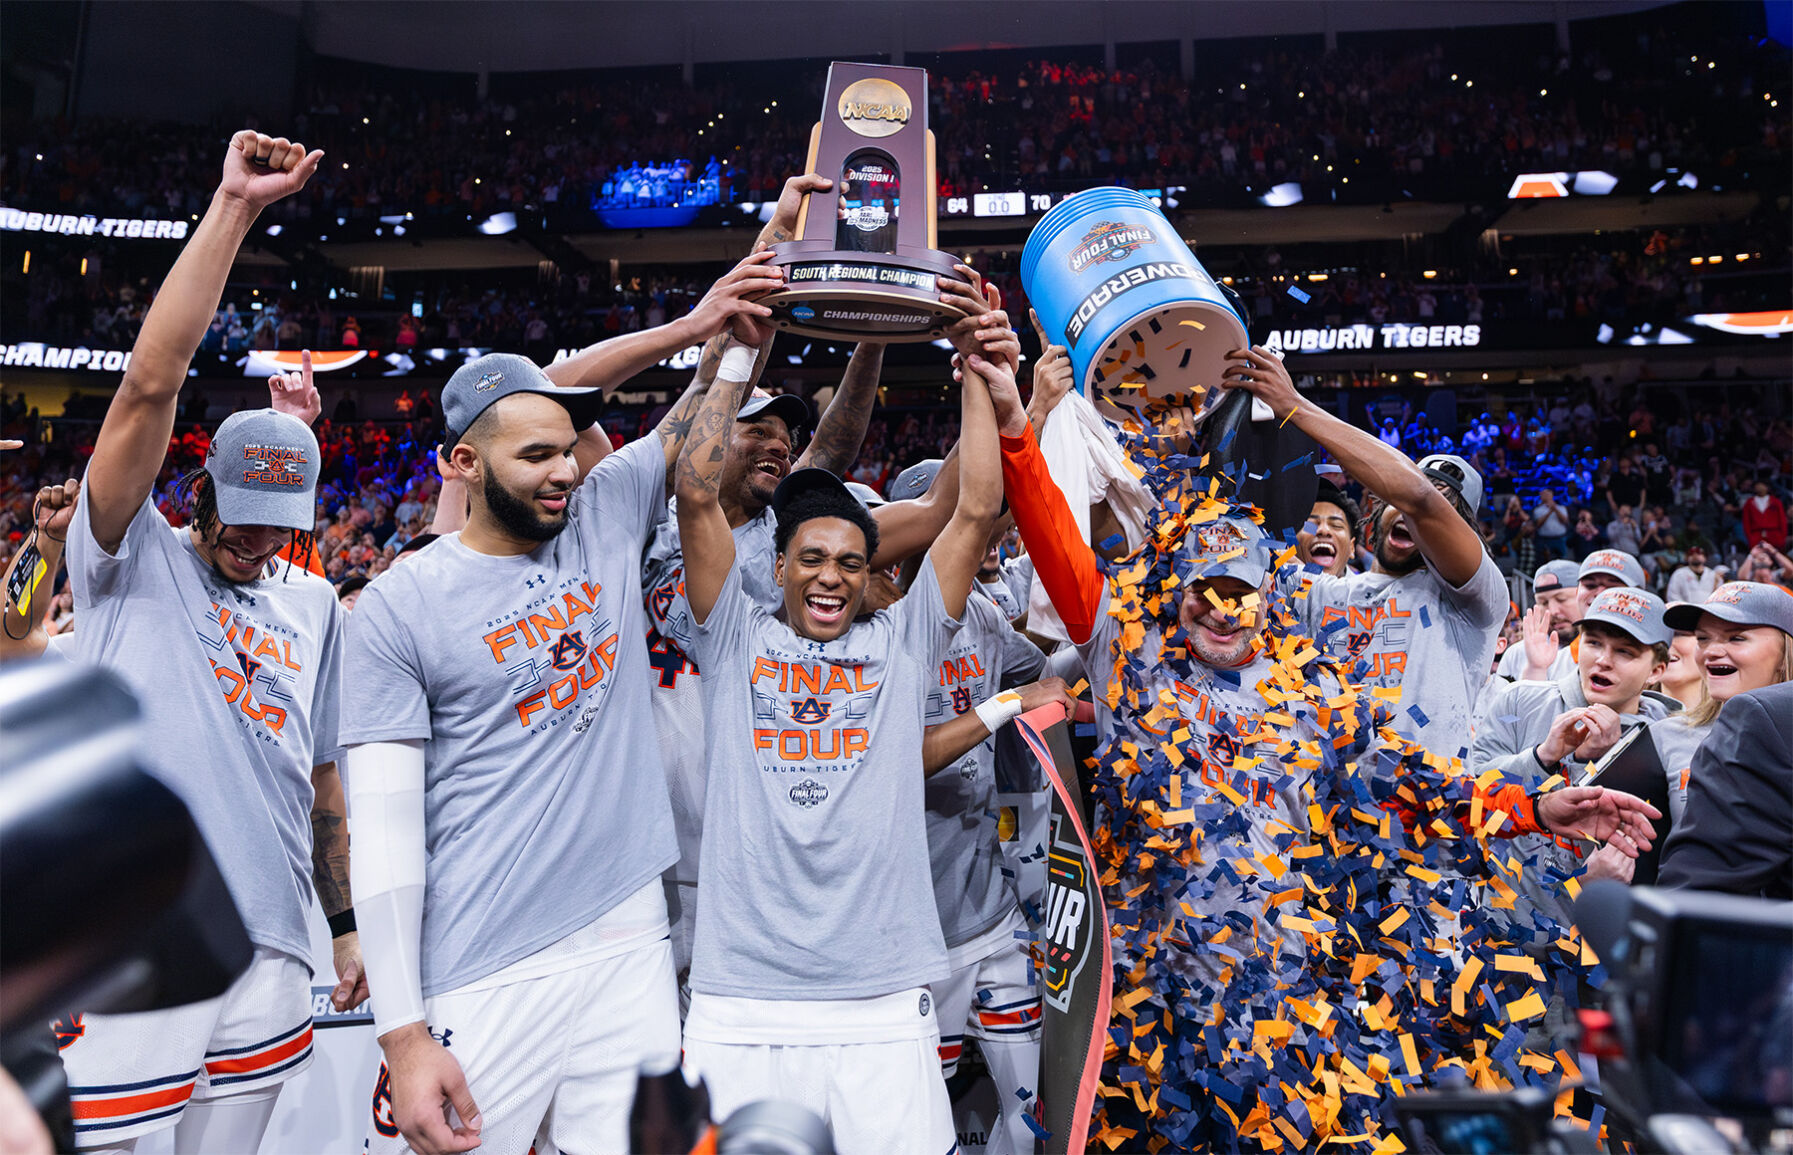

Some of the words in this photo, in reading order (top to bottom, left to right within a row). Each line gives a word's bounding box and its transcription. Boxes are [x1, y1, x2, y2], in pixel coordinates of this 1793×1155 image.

[843, 102, 908, 124] NCAA
[849, 172, 889, 183] DIVISION
[889, 174, 895, 183] I
[861, 165, 883, 173] 2025
[947, 197, 968, 213] 64
[1030, 194, 1051, 210] 70
[0, 207, 97, 236] AUBURN
[101, 218, 188, 239] TIGERS
[1108, 228, 1152, 246] FINAL
[1072, 238, 1109, 270] FOUR
[792, 266, 827, 281] SOUTH
[828, 266, 877, 280] REGIONAL
[880, 269, 934, 290] CHAMPION
[823, 310, 930, 325] CHAMPIONSHIPS
[1265, 328, 1374, 350] AUBURN
[1381, 324, 1480, 348] TIGERS
[244, 447, 307, 463] FINAL
[244, 471, 304, 486] FOUR
[482, 581, 602, 664] FINAL
[1321, 597, 1411, 630] FNAL
[212, 601, 302, 673] INAL
[752, 655, 879, 695] FINAL
[939, 653, 985, 687] INAL
[208, 657, 288, 738] OUR
[238, 717, 280, 747] TIERS
[531, 704, 580, 736] AUBURN
[754, 728, 870, 761] FOUR
[763, 764, 806, 773] UBURN
[791, 788, 809, 800] FINAL
[809, 788, 827, 800] FOUR
[1046, 882, 1086, 951] UR
[957, 1131, 989, 1146] NAL
